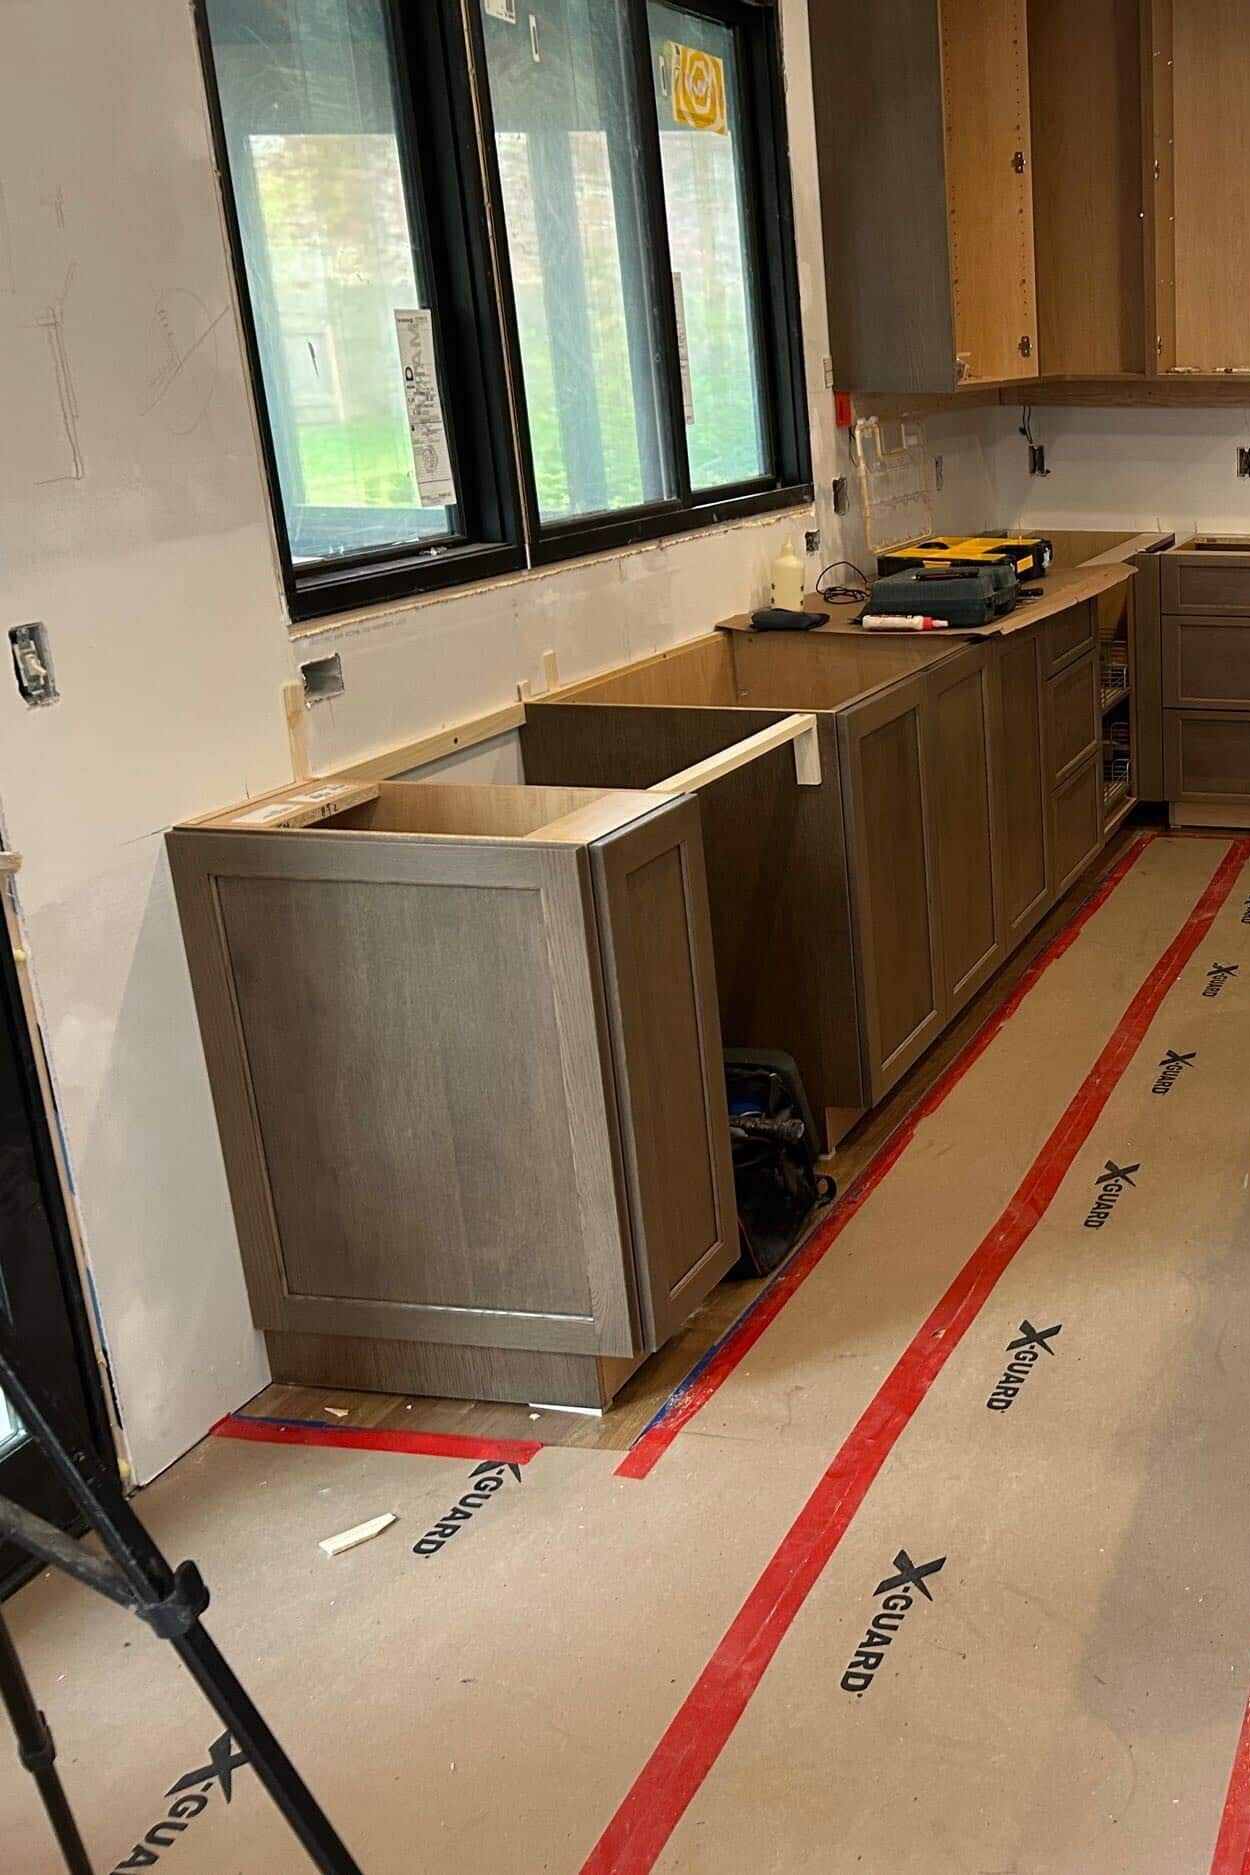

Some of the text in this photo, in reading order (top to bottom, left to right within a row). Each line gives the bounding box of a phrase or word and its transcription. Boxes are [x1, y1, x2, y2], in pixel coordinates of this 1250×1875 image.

[1202, 962, 1240, 997] X-GUARD
[1152, 1050, 1197, 1095] X-GUARD
[1083, 1160, 1141, 1230] X-GUARD
[986, 1319, 1063, 1413] X-GUARD
[841, 1549, 947, 1698] X-GUARD
[109, 1729, 251, 1875] X-GUA
